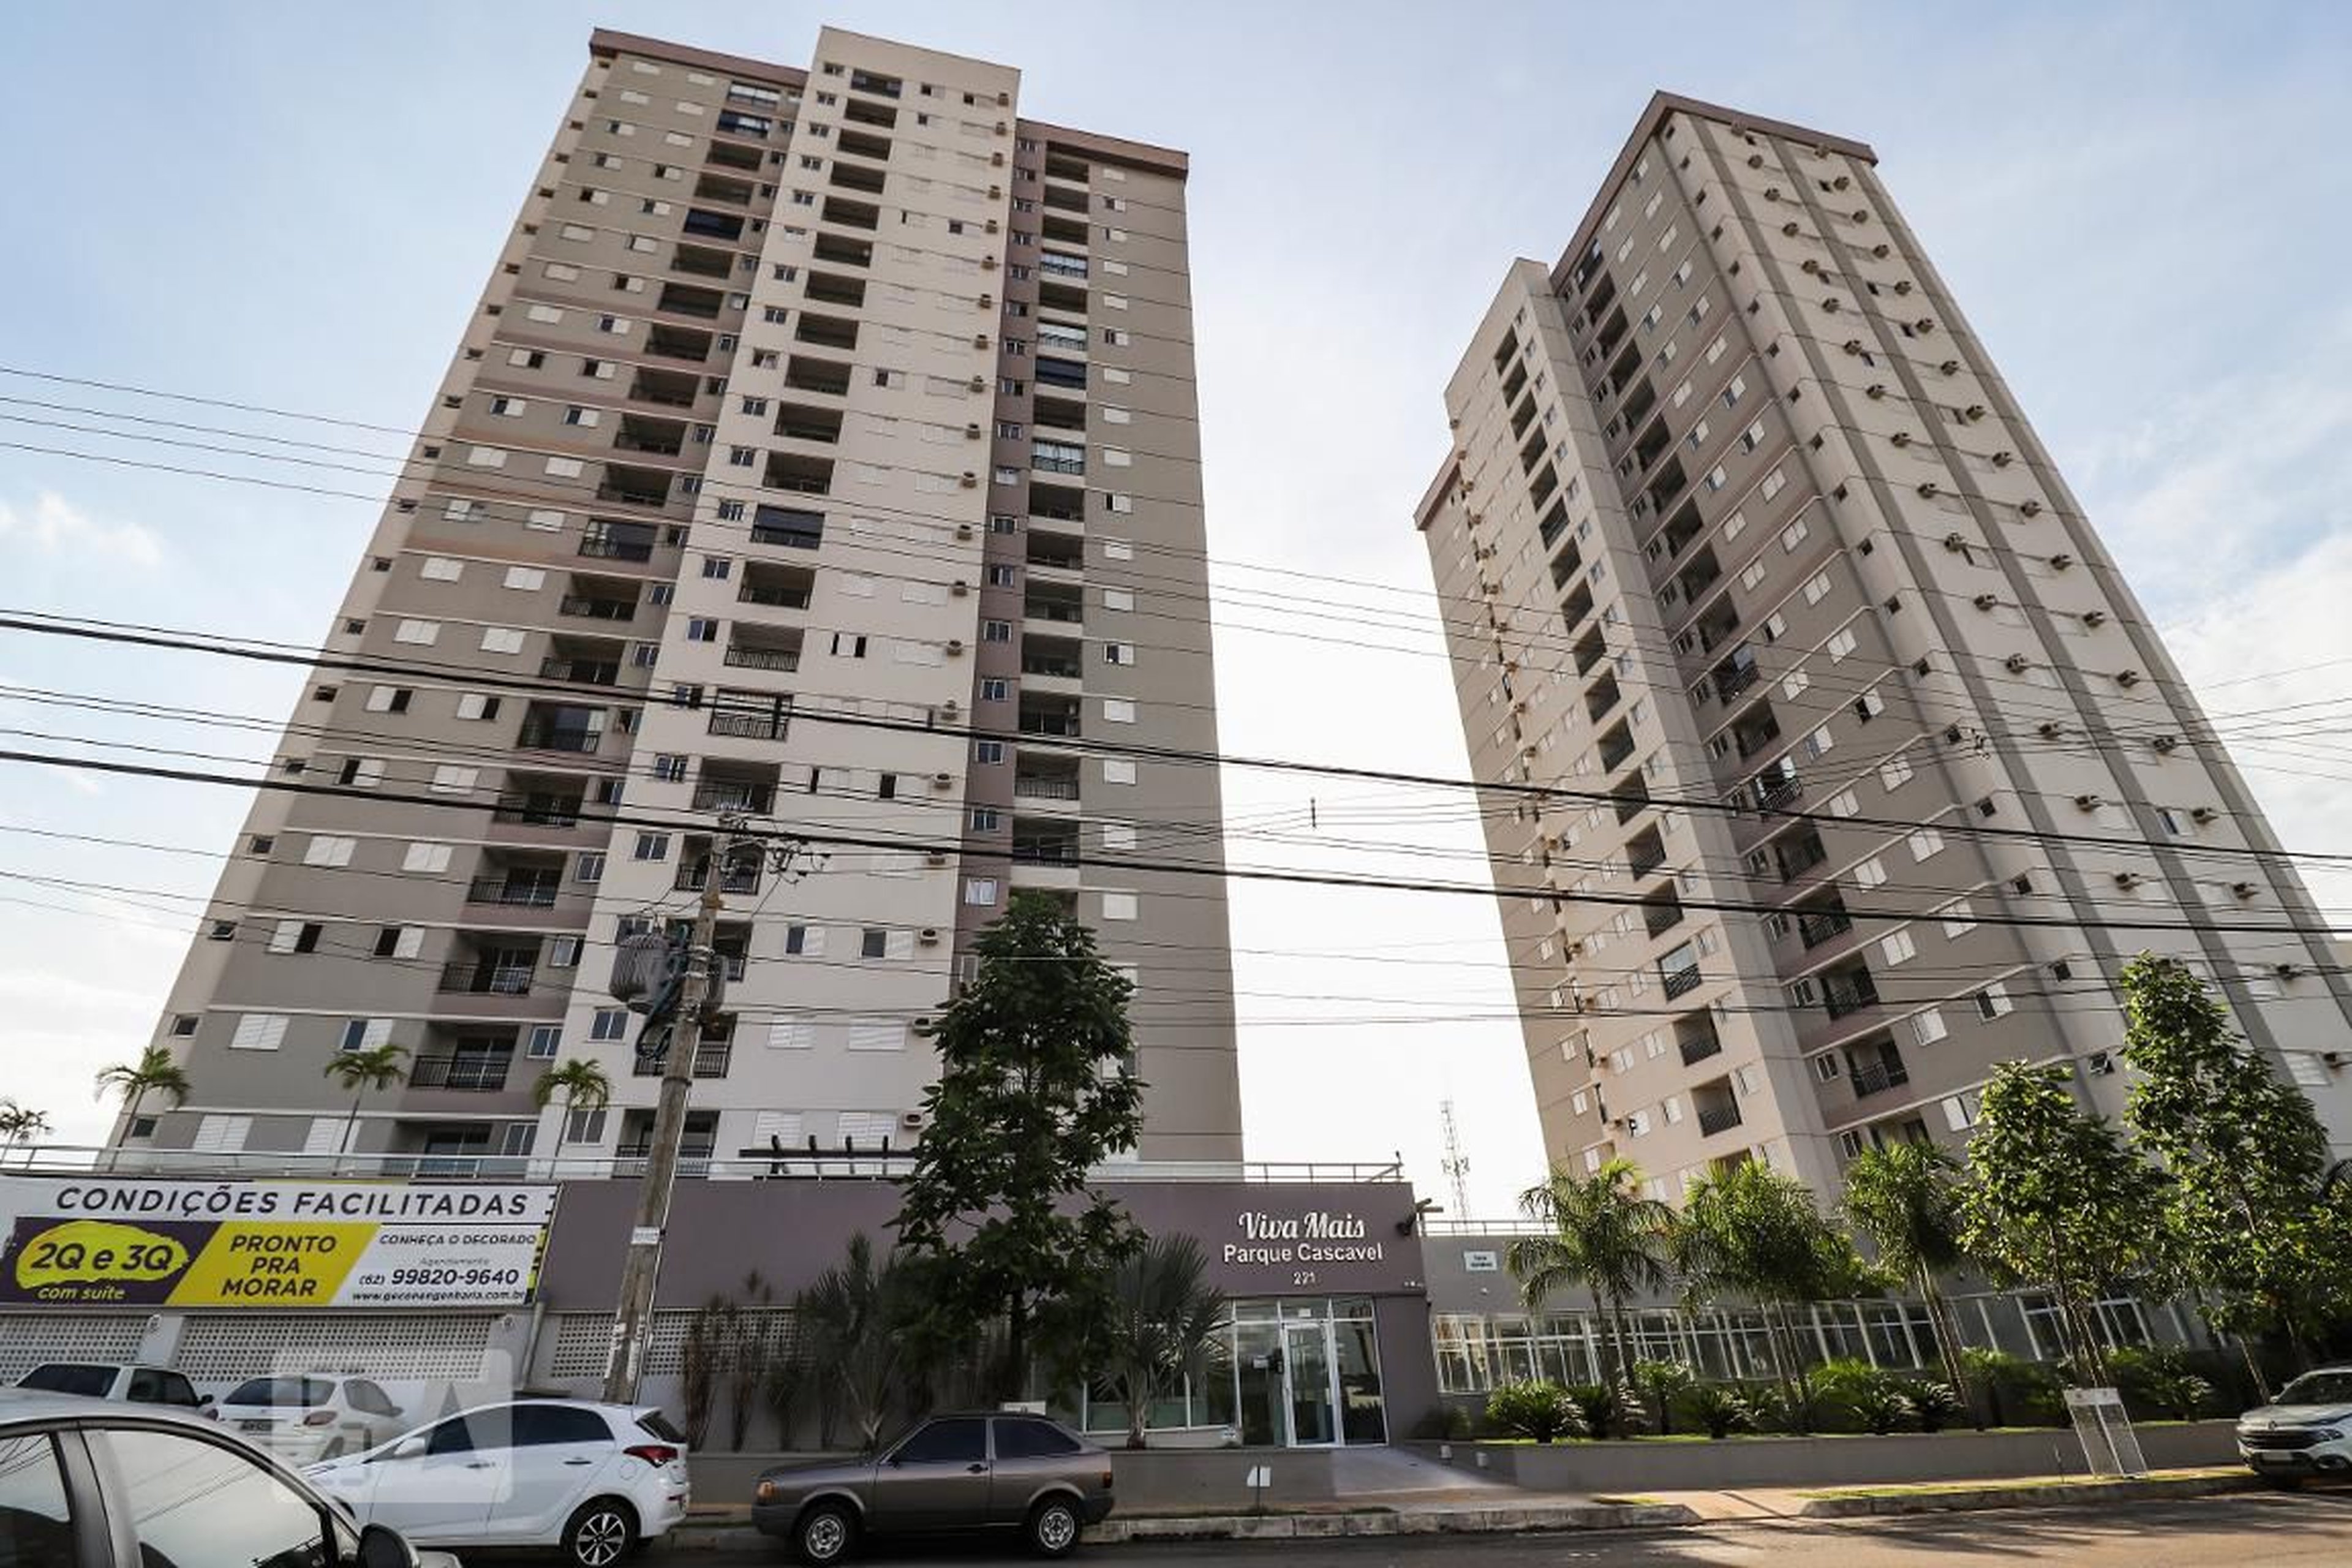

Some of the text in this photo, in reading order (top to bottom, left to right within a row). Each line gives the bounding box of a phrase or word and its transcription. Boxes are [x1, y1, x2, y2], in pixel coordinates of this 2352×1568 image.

[56, 1185, 528, 1216] CONDIÇÕES FACILITADAS
[1238, 1212, 1365, 1239] Viva Mais
[229, 1234, 337, 1253] PRONTO
[380, 1234, 537, 1246] CONHEÇA O DECORADO
[31, 1242, 173, 1271] 2Q e 3Q
[1224, 1242, 1384, 1265] Parque Cascavel
[251, 1256, 300, 1275] PRA
[391, 1268, 520, 1286] 99820-9640
[37, 1287, 77, 1300] com
[221, 1277, 317, 1297] MORAR
